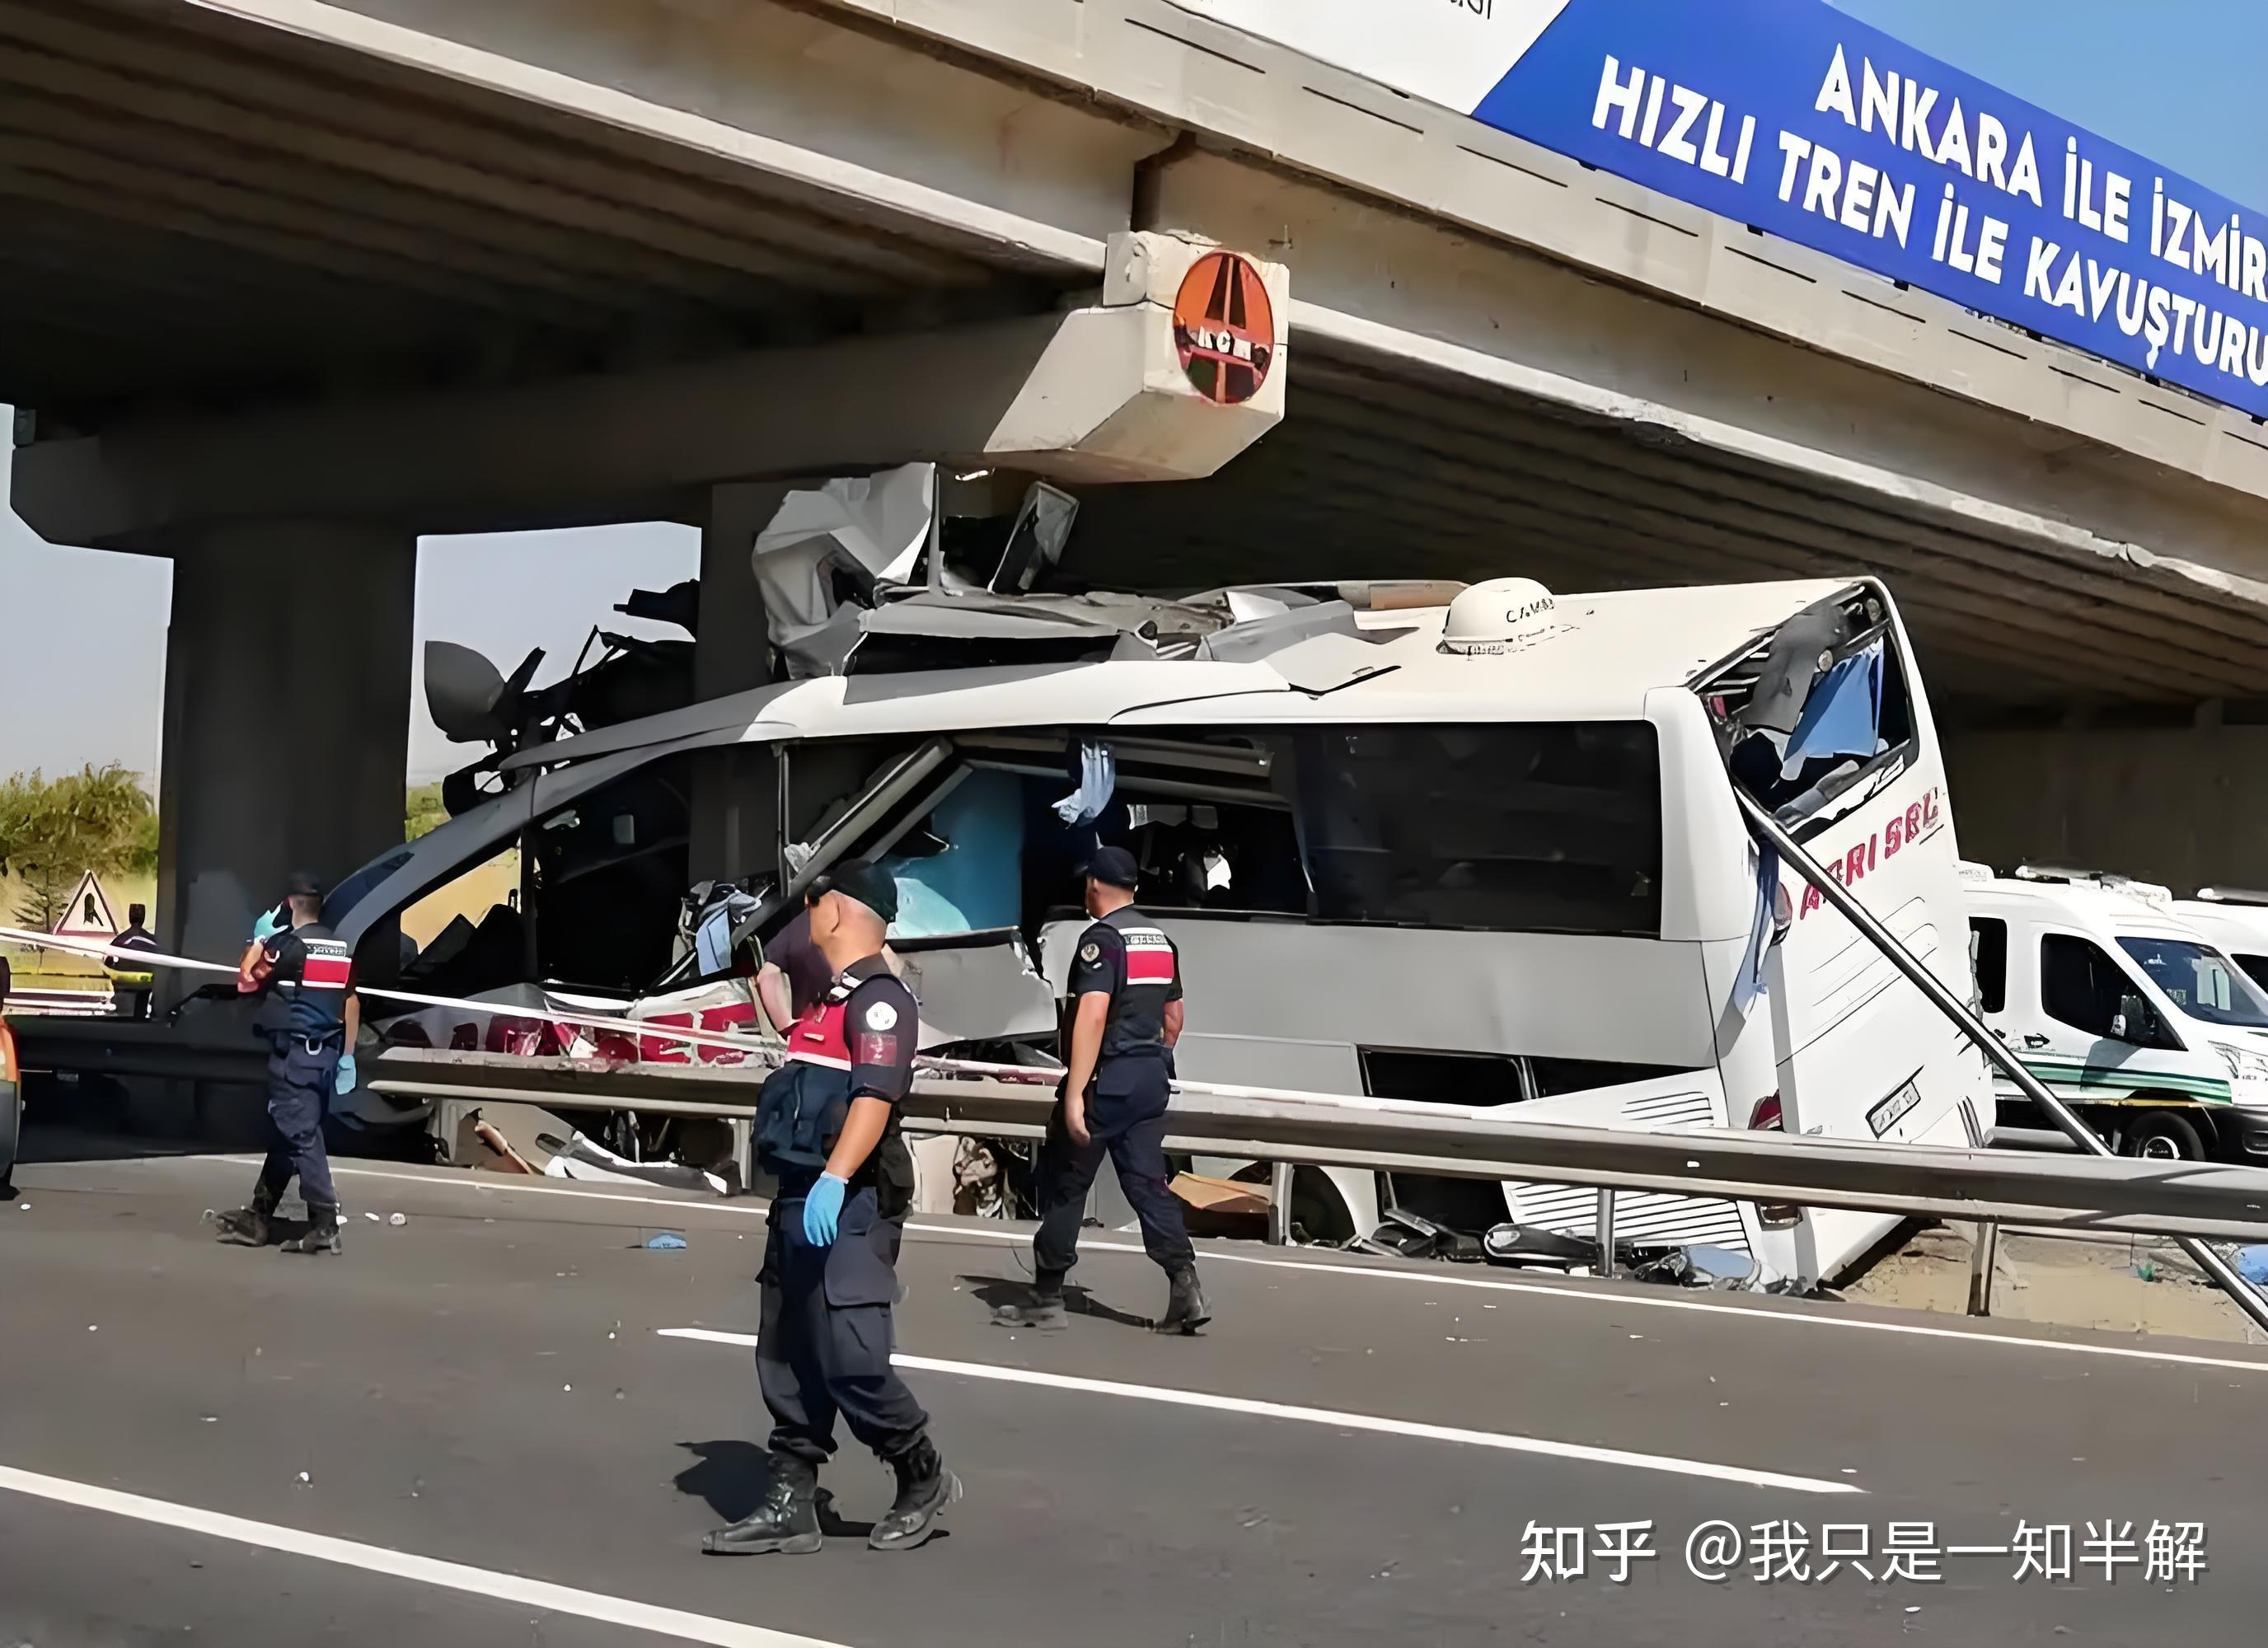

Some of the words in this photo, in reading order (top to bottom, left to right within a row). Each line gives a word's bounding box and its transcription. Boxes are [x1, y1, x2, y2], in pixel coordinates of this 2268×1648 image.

[1591, 54, 1756, 185] HIZLI
[1777, 129, 1916, 249] TREN
[1932, 182, 2009, 284] İLE
[1815, 43, 2043, 208] ANKARA
[2063, 136, 2132, 243] İLE
[2150, 176, 2268, 303] İZMİR
